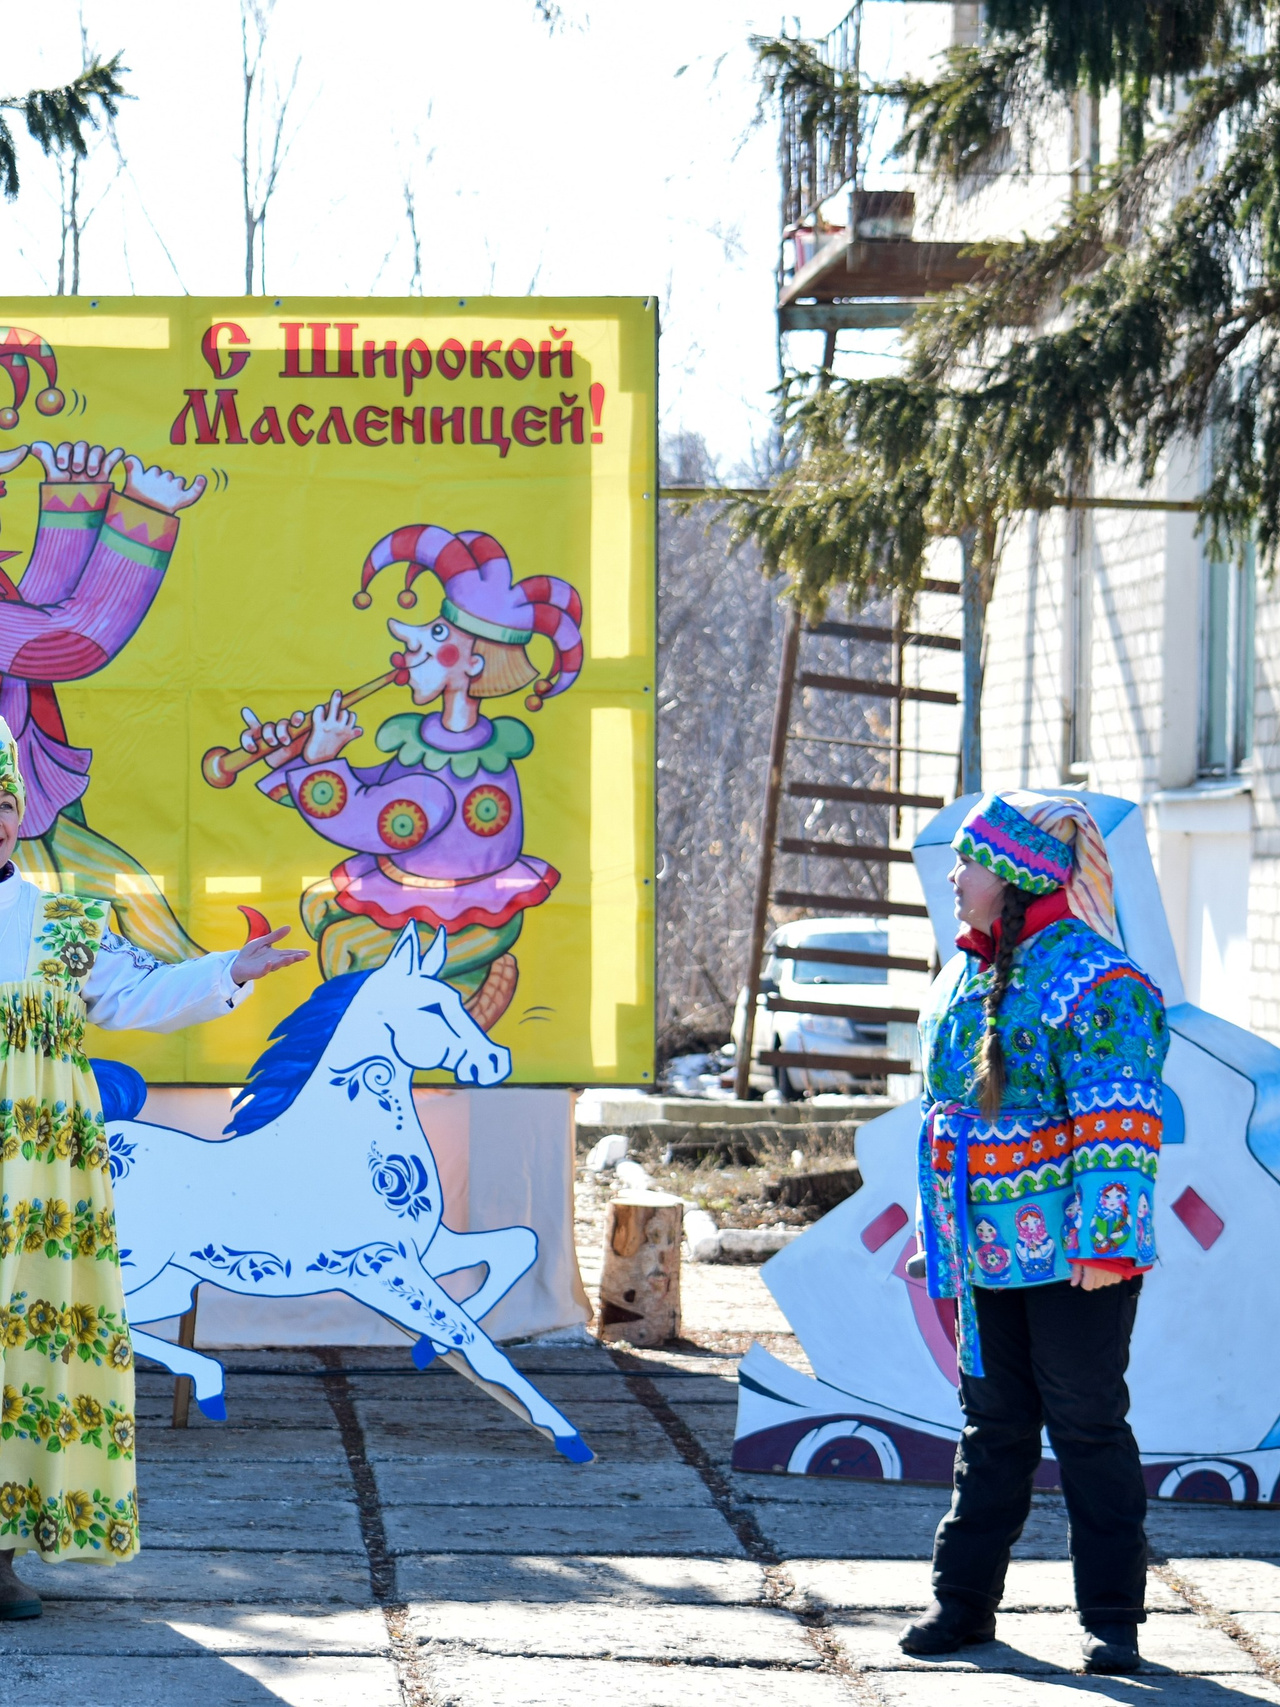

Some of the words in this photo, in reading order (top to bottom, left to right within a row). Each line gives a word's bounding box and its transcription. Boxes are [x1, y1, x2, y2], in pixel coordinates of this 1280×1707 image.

[201, 322, 251, 379] С
[279, 322, 574, 397] Широкой
[170, 382, 605, 458] Масленицей!
